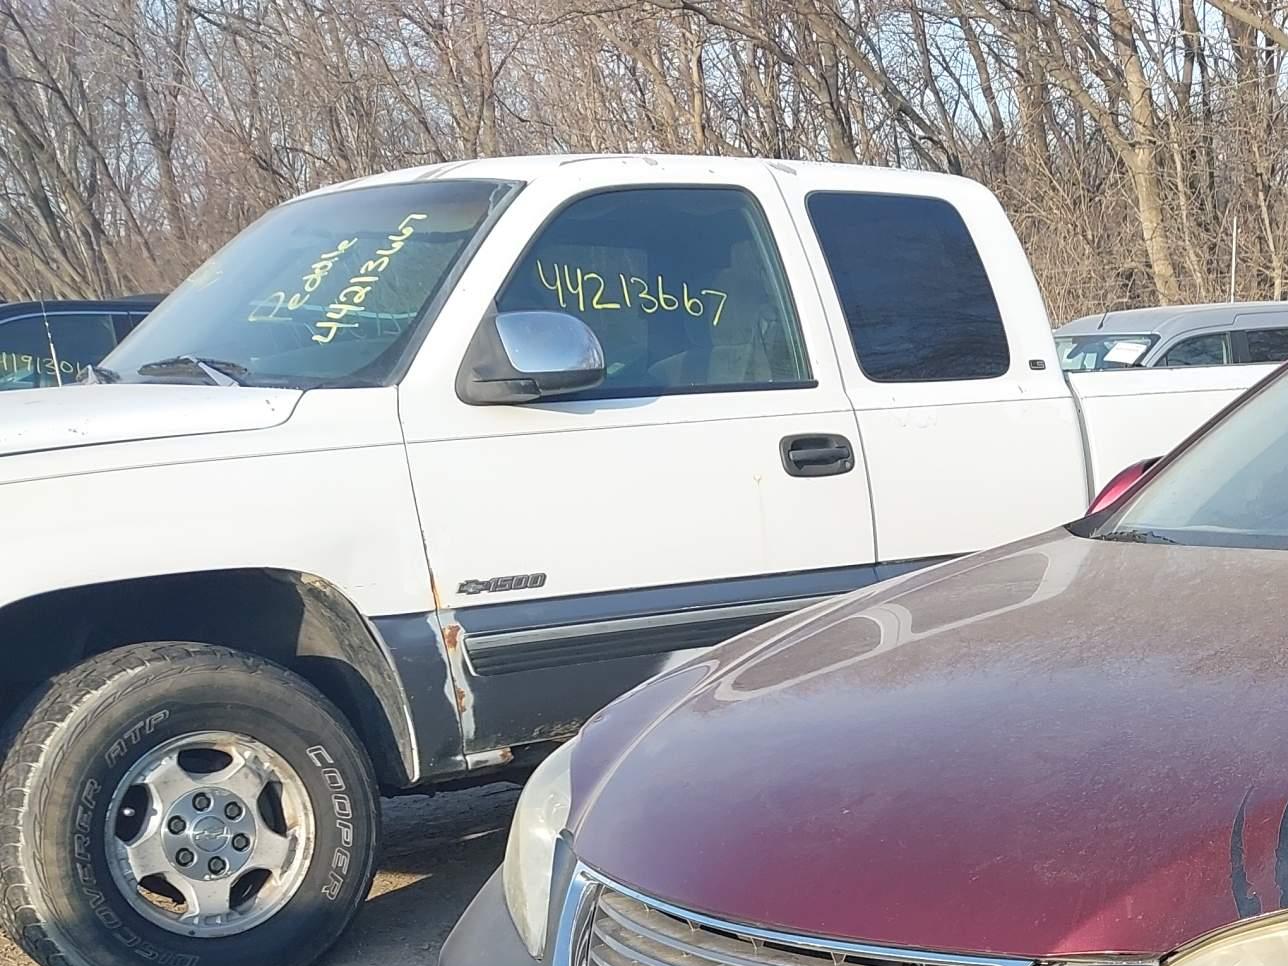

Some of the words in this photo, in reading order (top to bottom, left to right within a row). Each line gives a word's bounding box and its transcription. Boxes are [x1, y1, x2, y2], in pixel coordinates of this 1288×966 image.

[312, 213, 427, 343] 44213667
[536, 259, 728, 326] 44213667
[489, 573, 547, 592] 1500
[105, 709, 169, 769] ATP
[306, 745, 354, 901] COOPER
